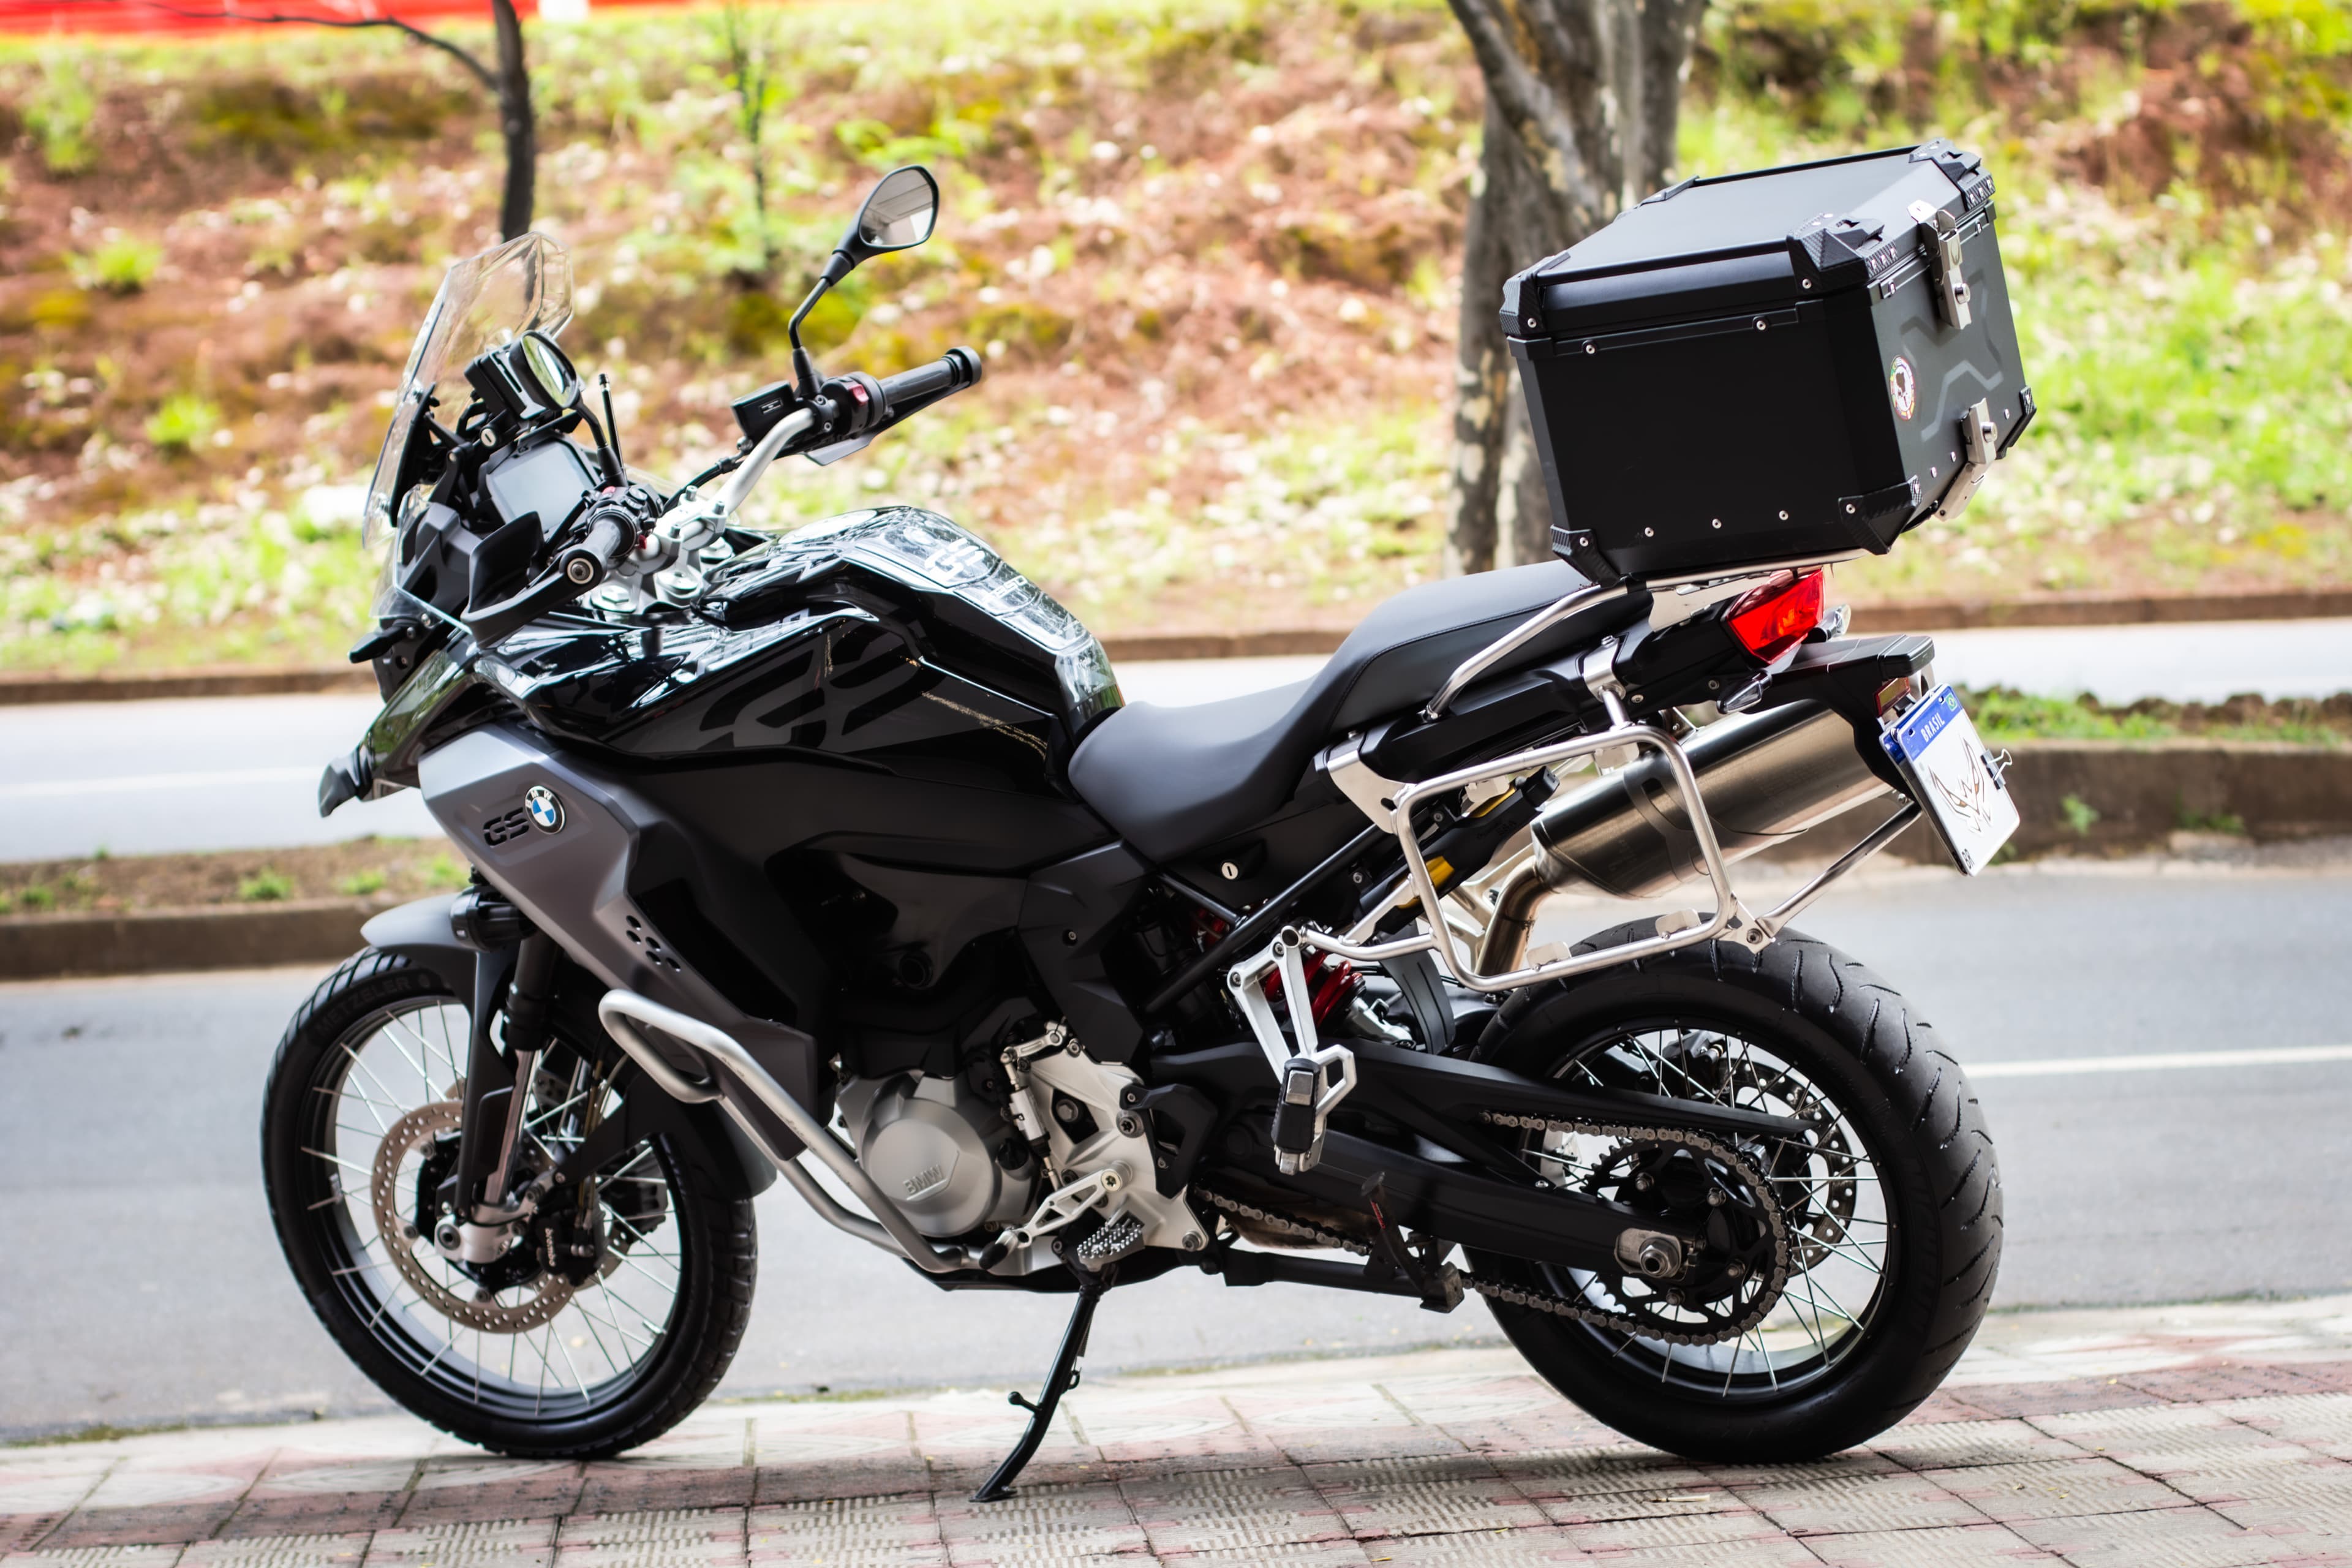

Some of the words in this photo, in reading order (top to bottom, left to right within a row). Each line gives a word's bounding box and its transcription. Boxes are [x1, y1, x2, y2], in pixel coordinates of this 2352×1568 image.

[1920, 712, 1945, 743] BRASIL
[483, 807, 529, 846] GS
[316, 975, 412, 1038] METZELER
[902, 1164, 943, 1194] BMW
[545, 1227, 556, 1267] brembo
